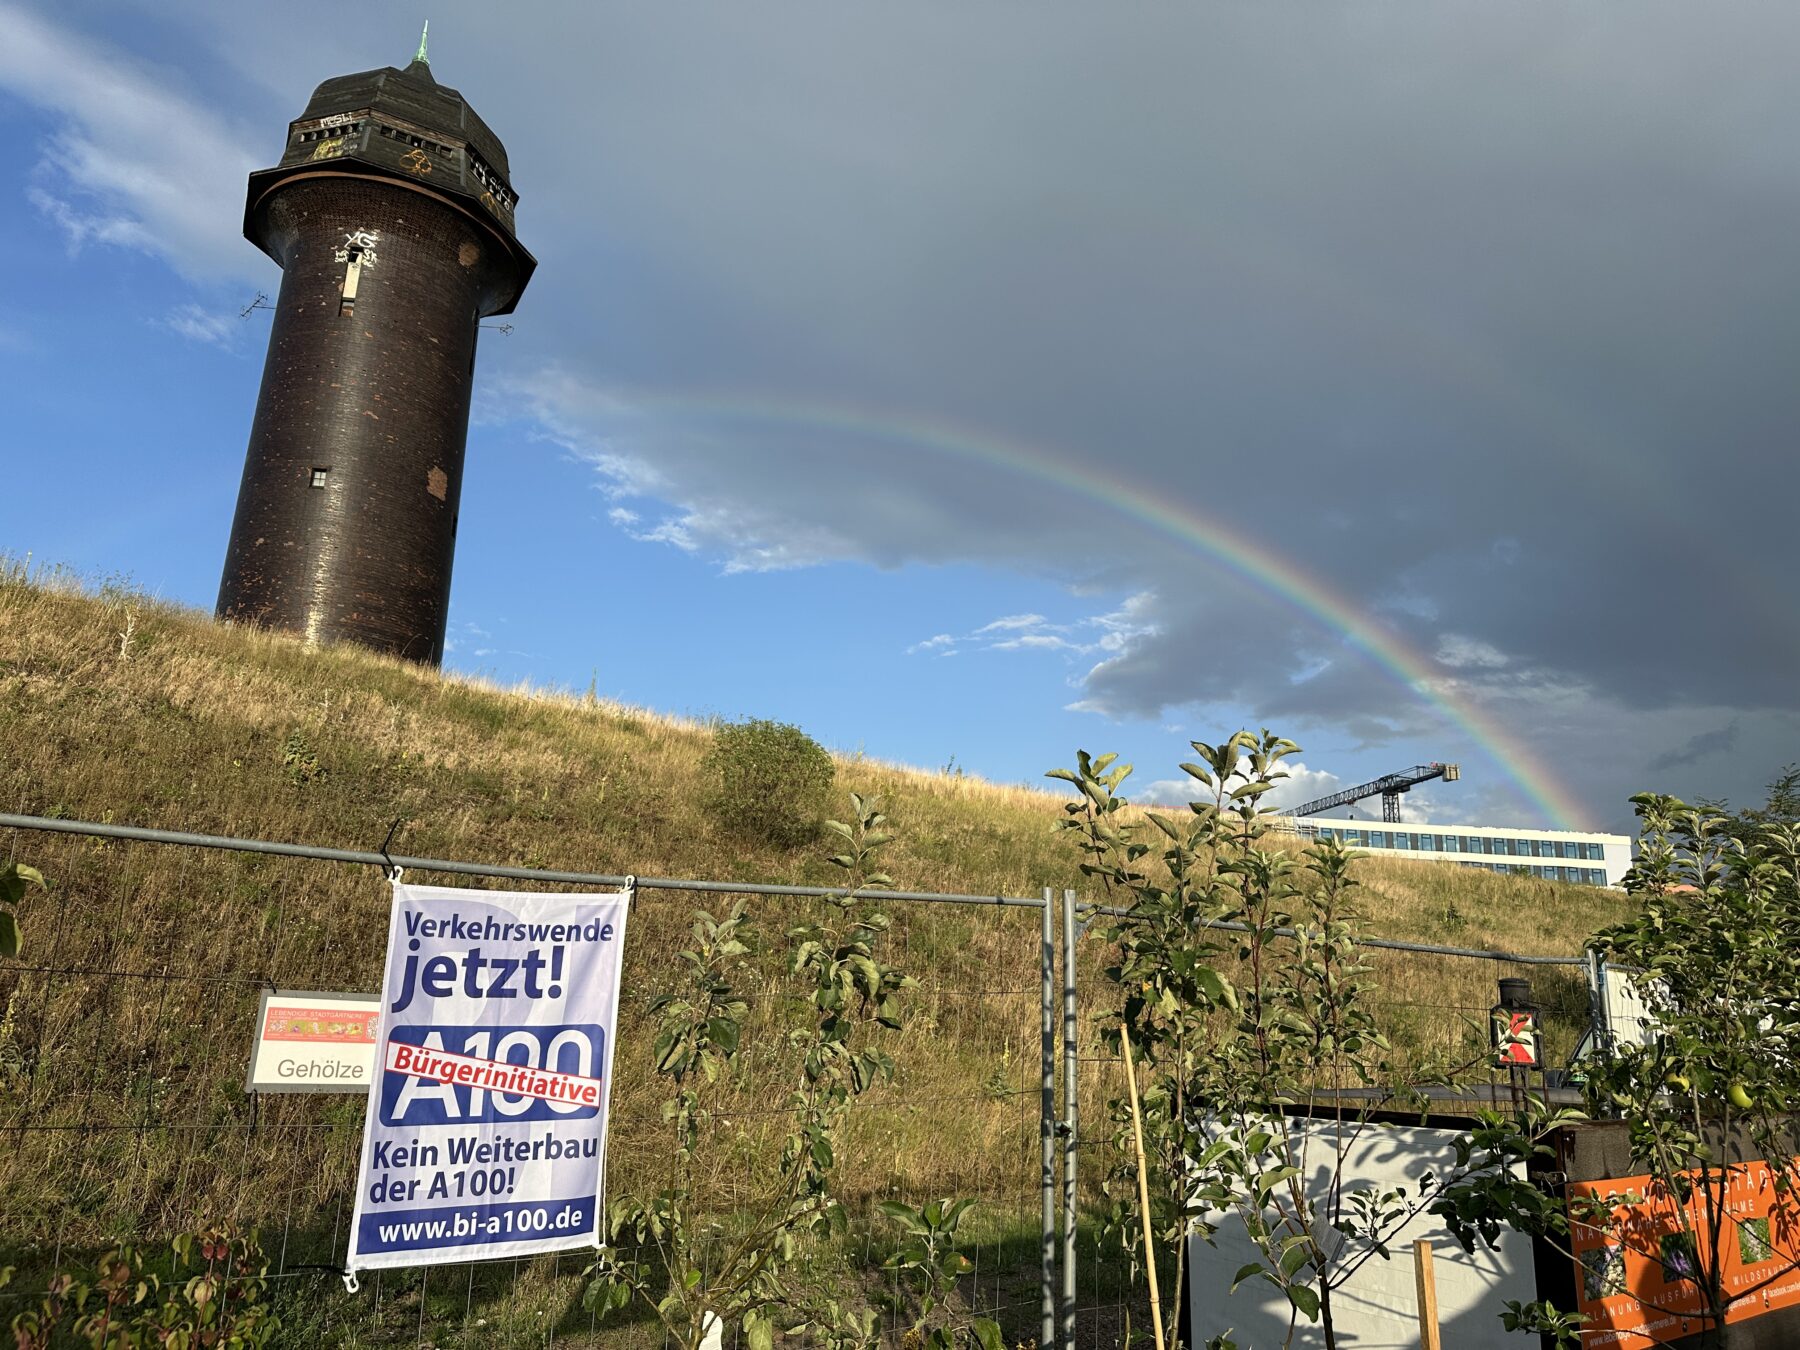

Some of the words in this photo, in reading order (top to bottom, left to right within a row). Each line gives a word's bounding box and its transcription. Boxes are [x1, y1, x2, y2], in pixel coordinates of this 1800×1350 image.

[405, 911, 614, 943] Verkehrswende
[392, 938, 564, 1014] jetzt!
[277, 1058, 364, 1080] Gehölze
[391, 1029, 594, 1121] A100
[394, 1046, 598, 1104] Bürgerinitiative
[373, 1139, 438, 1170] Kein
[448, 1133, 598, 1166] Weiterbau
[370, 1174, 421, 1204] der
[427, 1167, 515, 1200] A100!
[379, 1205, 583, 1243] www.bi-a100.de
